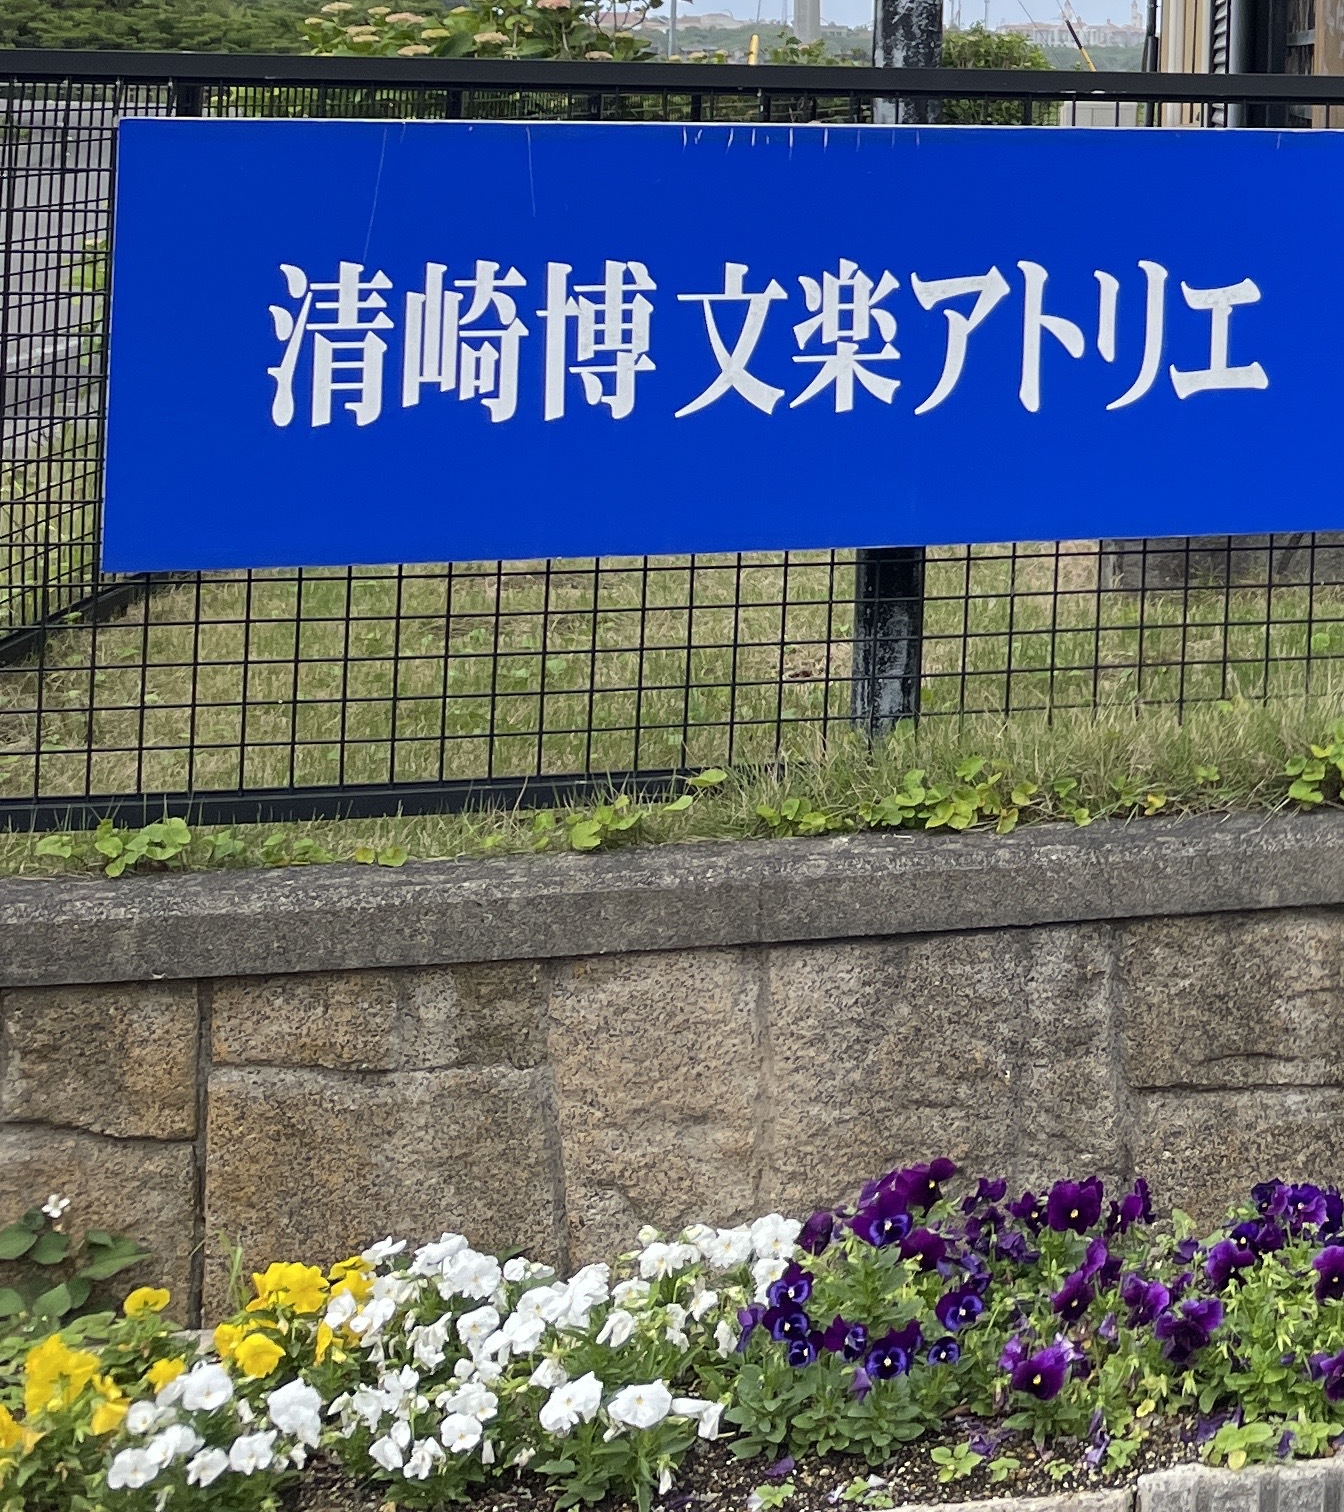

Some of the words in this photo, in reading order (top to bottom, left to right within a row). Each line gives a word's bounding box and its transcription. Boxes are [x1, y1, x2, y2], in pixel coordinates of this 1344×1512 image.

[267, 258, 1269, 428] 清崎博文楽アトリエ
